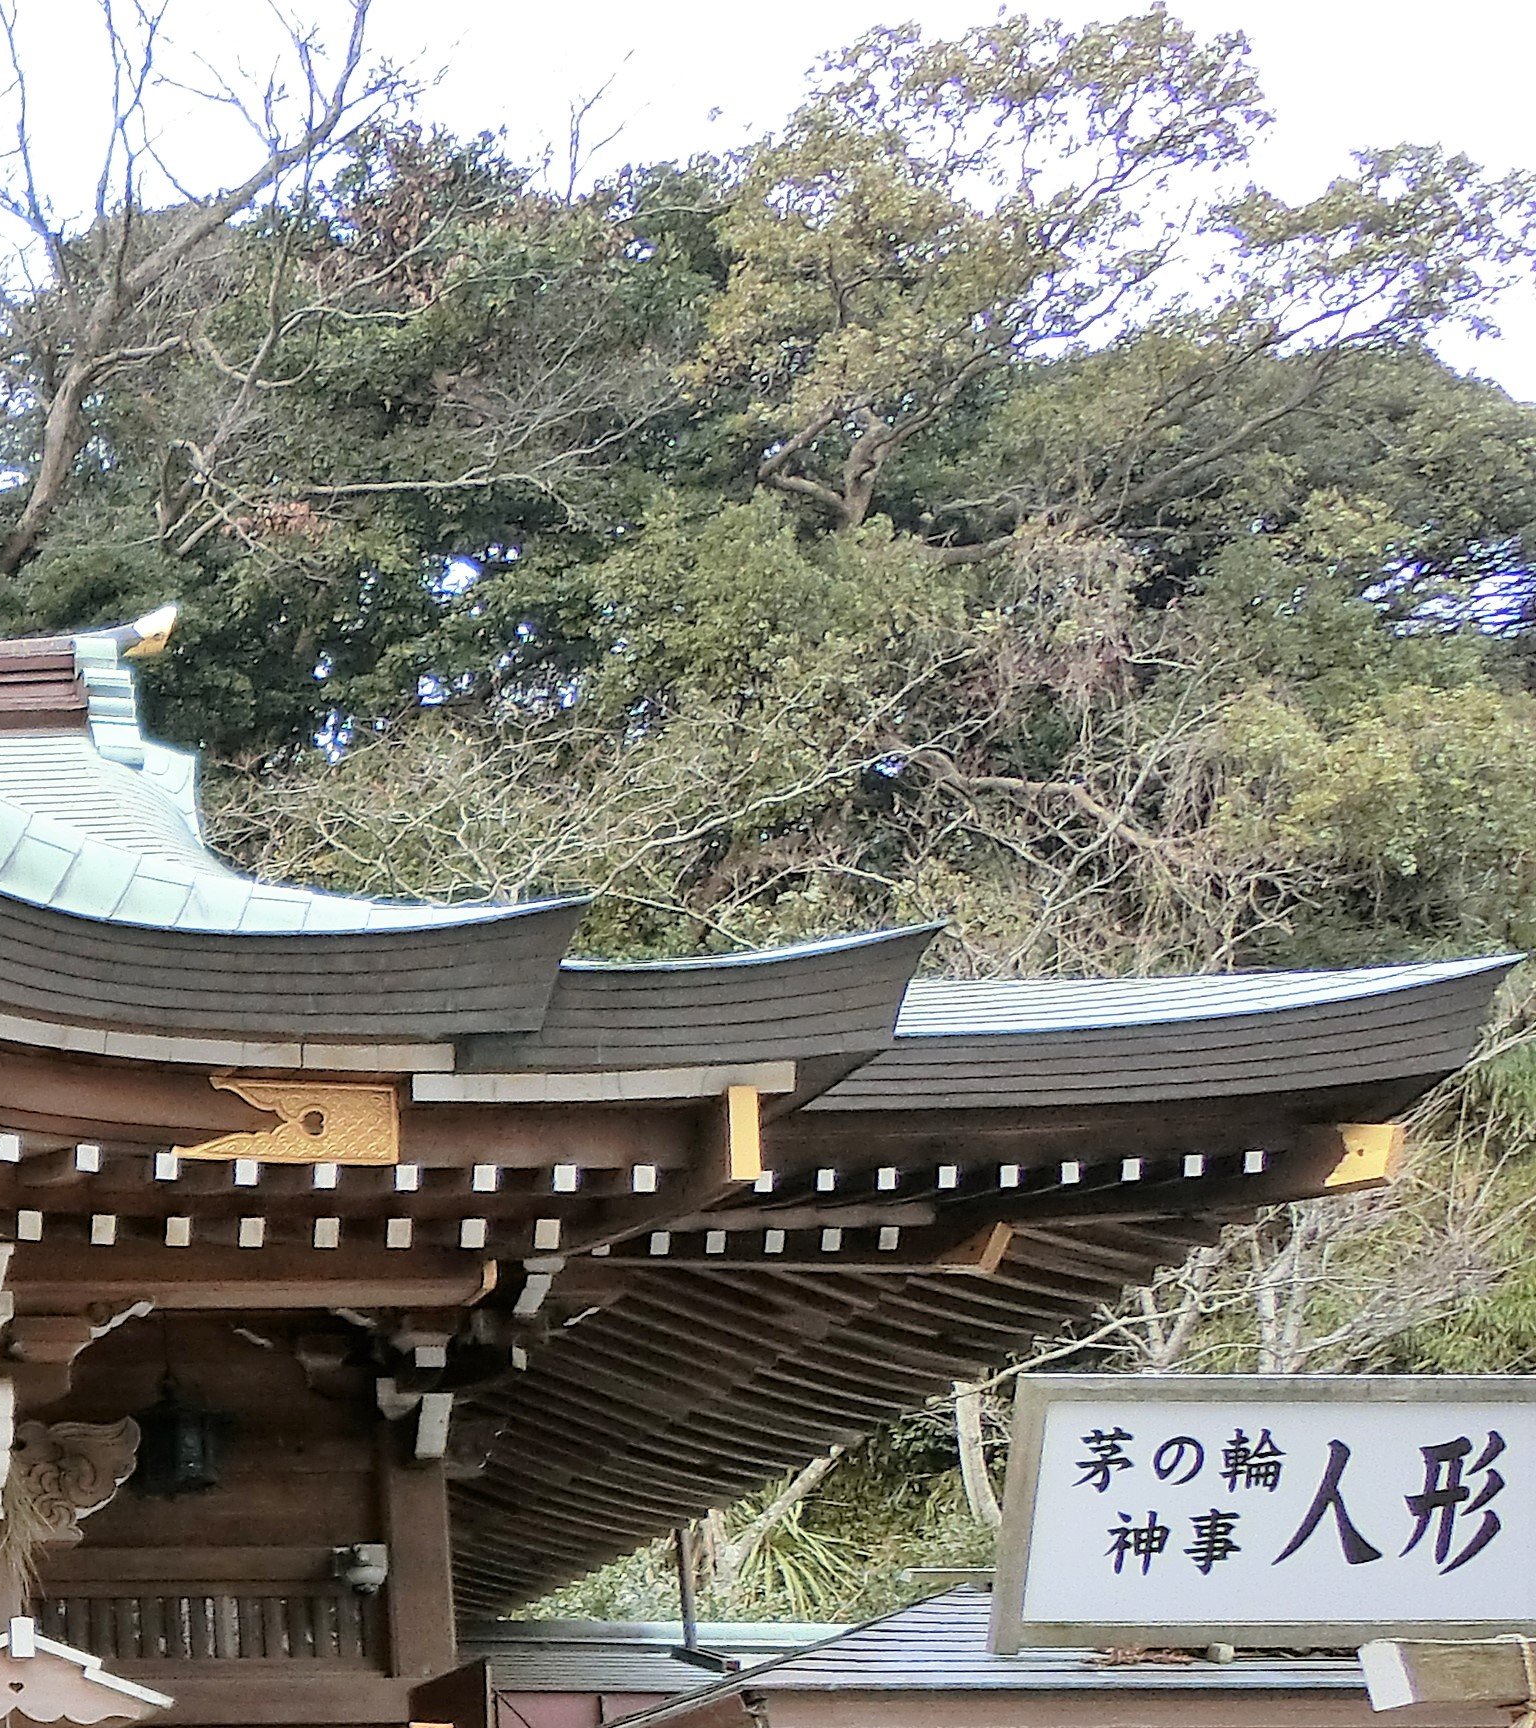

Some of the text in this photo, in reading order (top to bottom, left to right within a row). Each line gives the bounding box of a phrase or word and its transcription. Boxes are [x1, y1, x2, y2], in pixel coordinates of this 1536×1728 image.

[1072, 1426, 1287, 1494] 茅の輪
[1271, 1429, 1508, 1577] 人形
[1103, 1508, 1243, 1576] 神事
